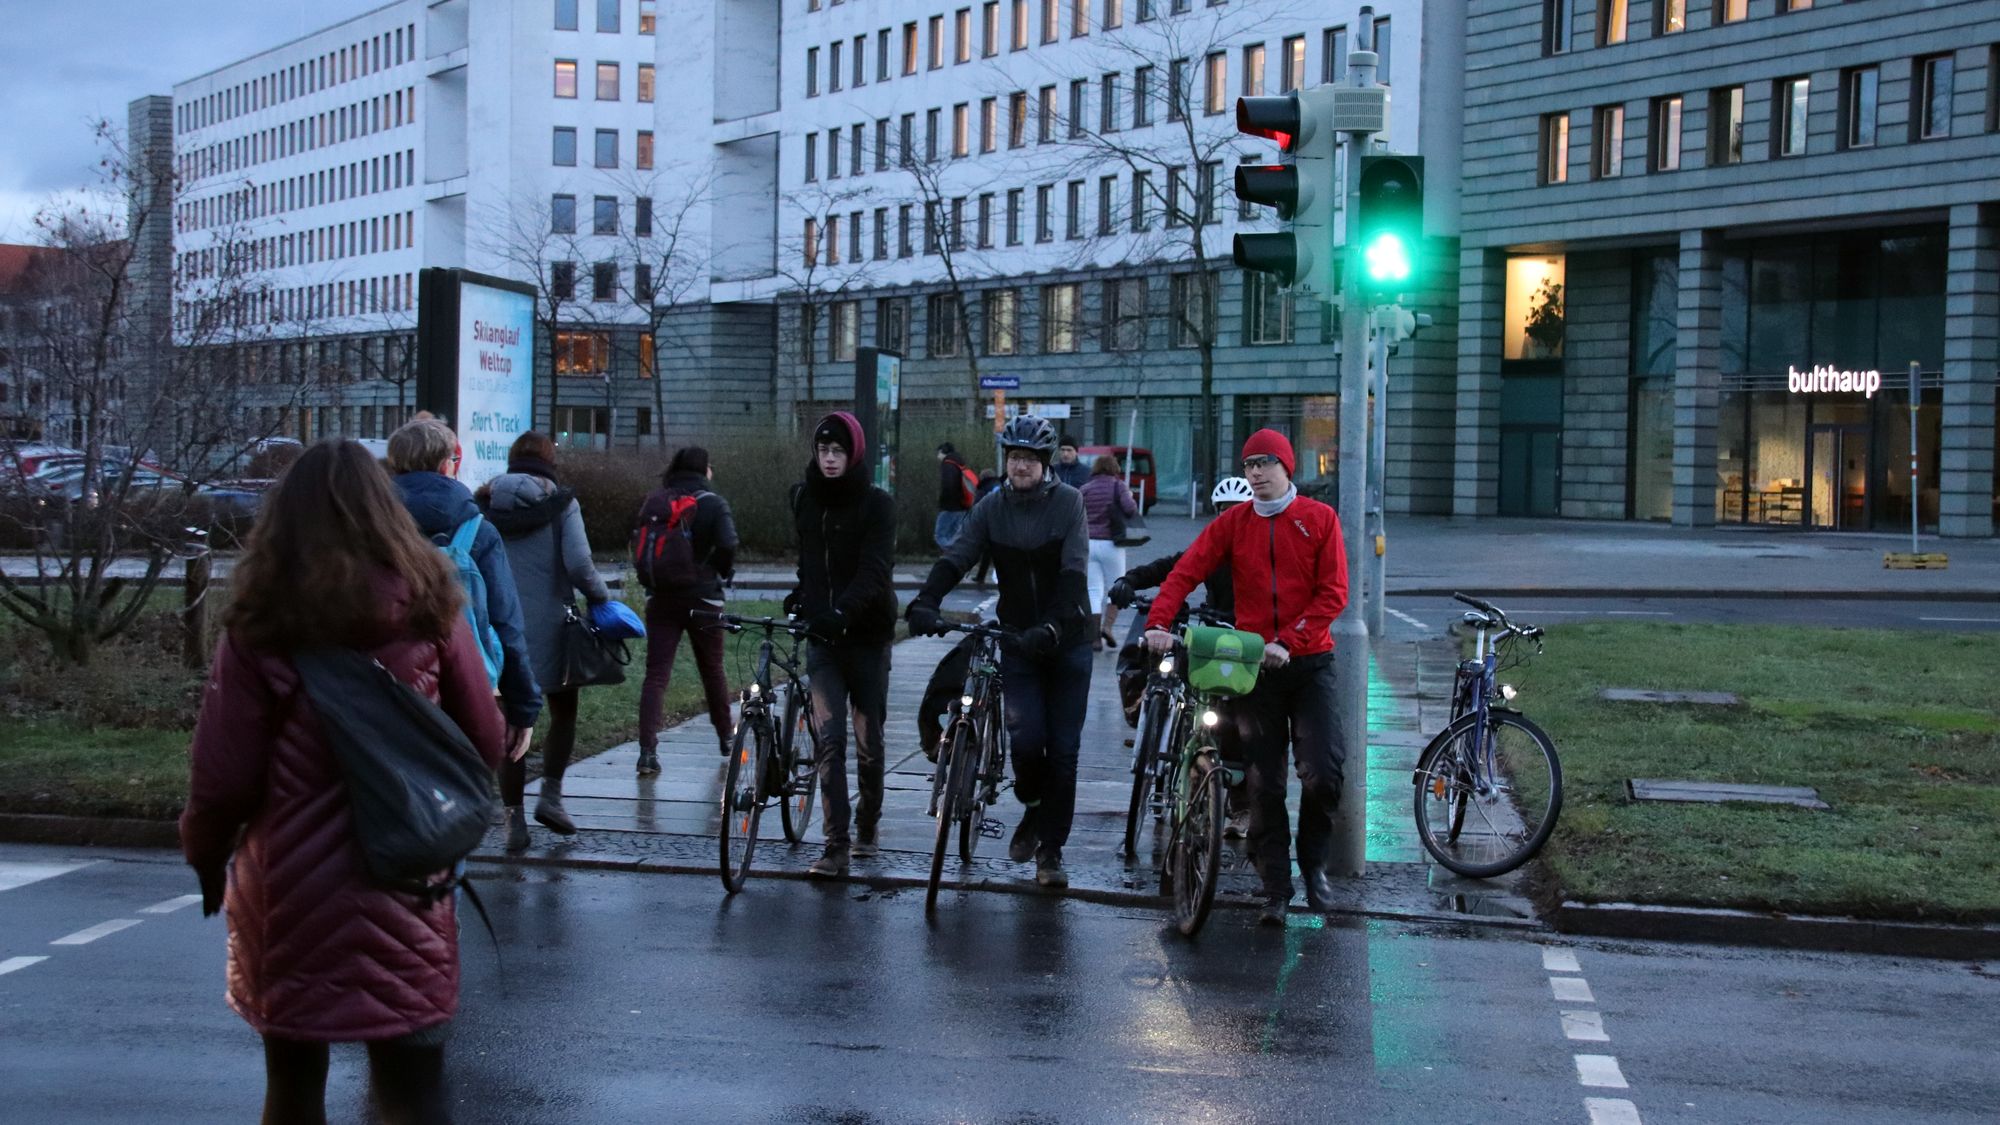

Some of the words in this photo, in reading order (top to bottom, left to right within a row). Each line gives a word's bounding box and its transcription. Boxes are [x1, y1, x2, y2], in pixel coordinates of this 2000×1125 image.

[474, 320, 520, 348] Skilanglauf
[480, 350, 512, 377] Weltcup
[1788, 364, 1880, 399] bulthaup
[470, 411, 493, 432] Short
[494, 412, 519, 433] Track
